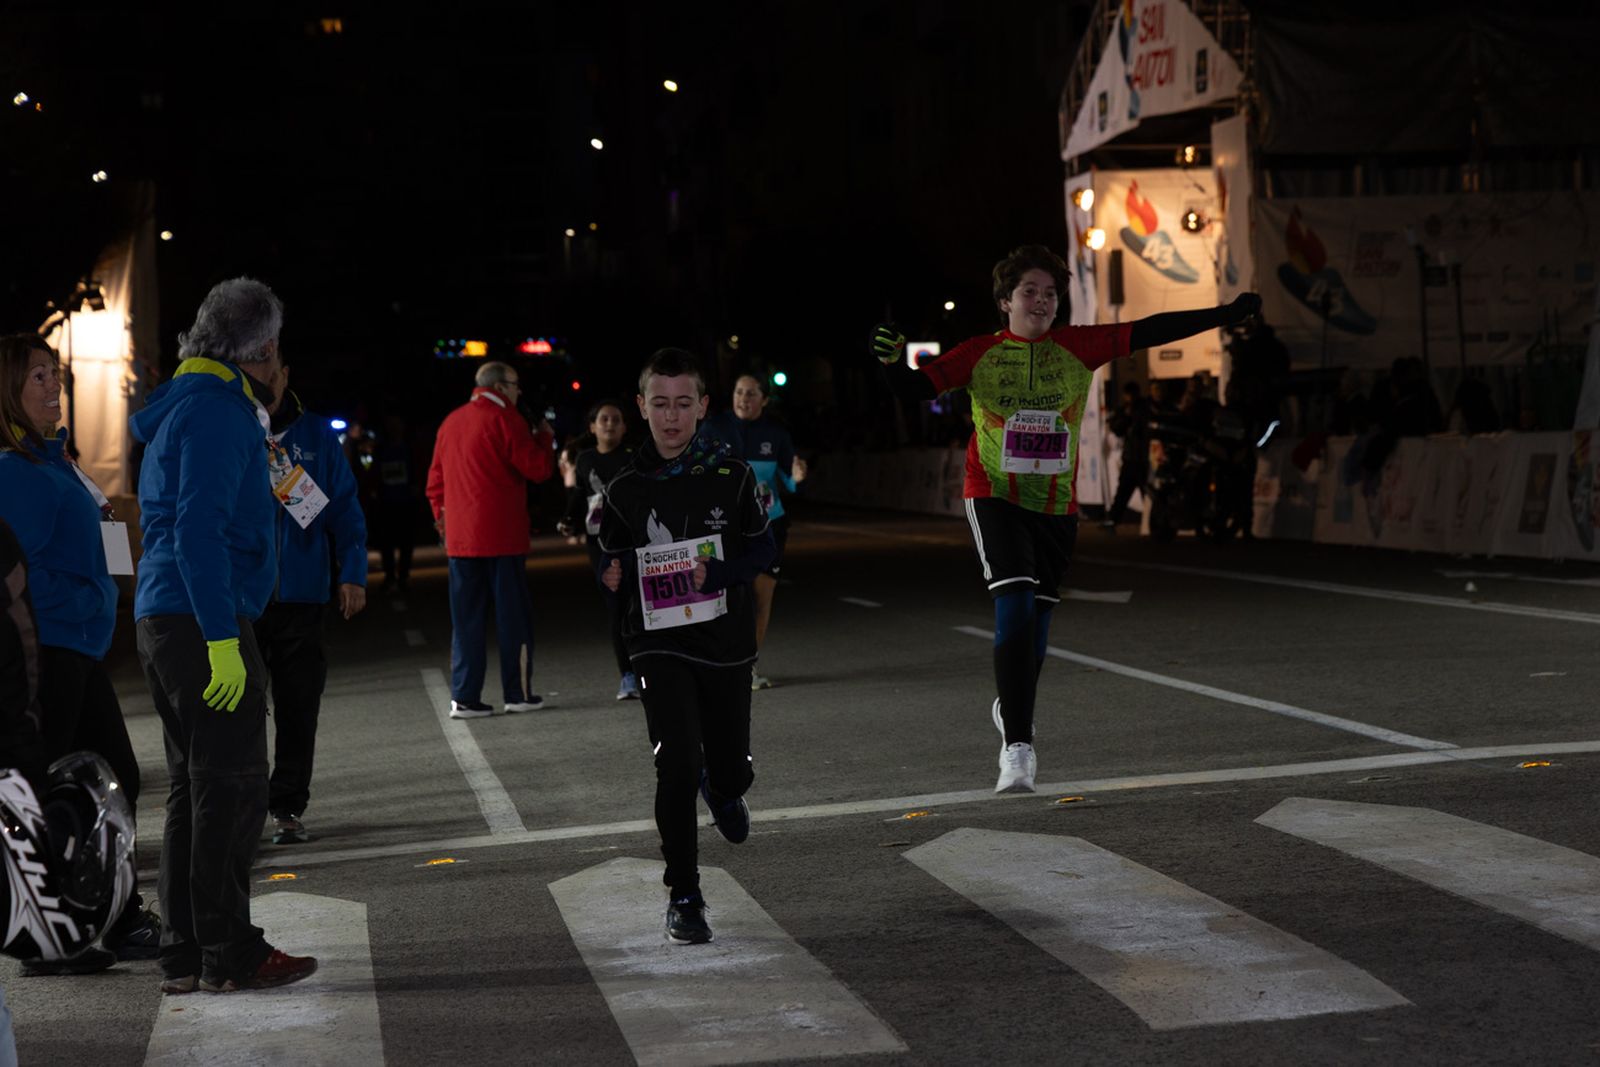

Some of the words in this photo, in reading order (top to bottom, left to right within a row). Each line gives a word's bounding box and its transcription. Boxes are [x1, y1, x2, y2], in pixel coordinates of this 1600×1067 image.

[1139, 4, 1165, 44] SAN
[1141, 238, 1175, 270] 43
[1013, 423, 1027, 431] SAN
[652, 551, 679, 564] NOCHE
[679, 550, 690, 560] DE
[645, 565, 661, 576] SAN
